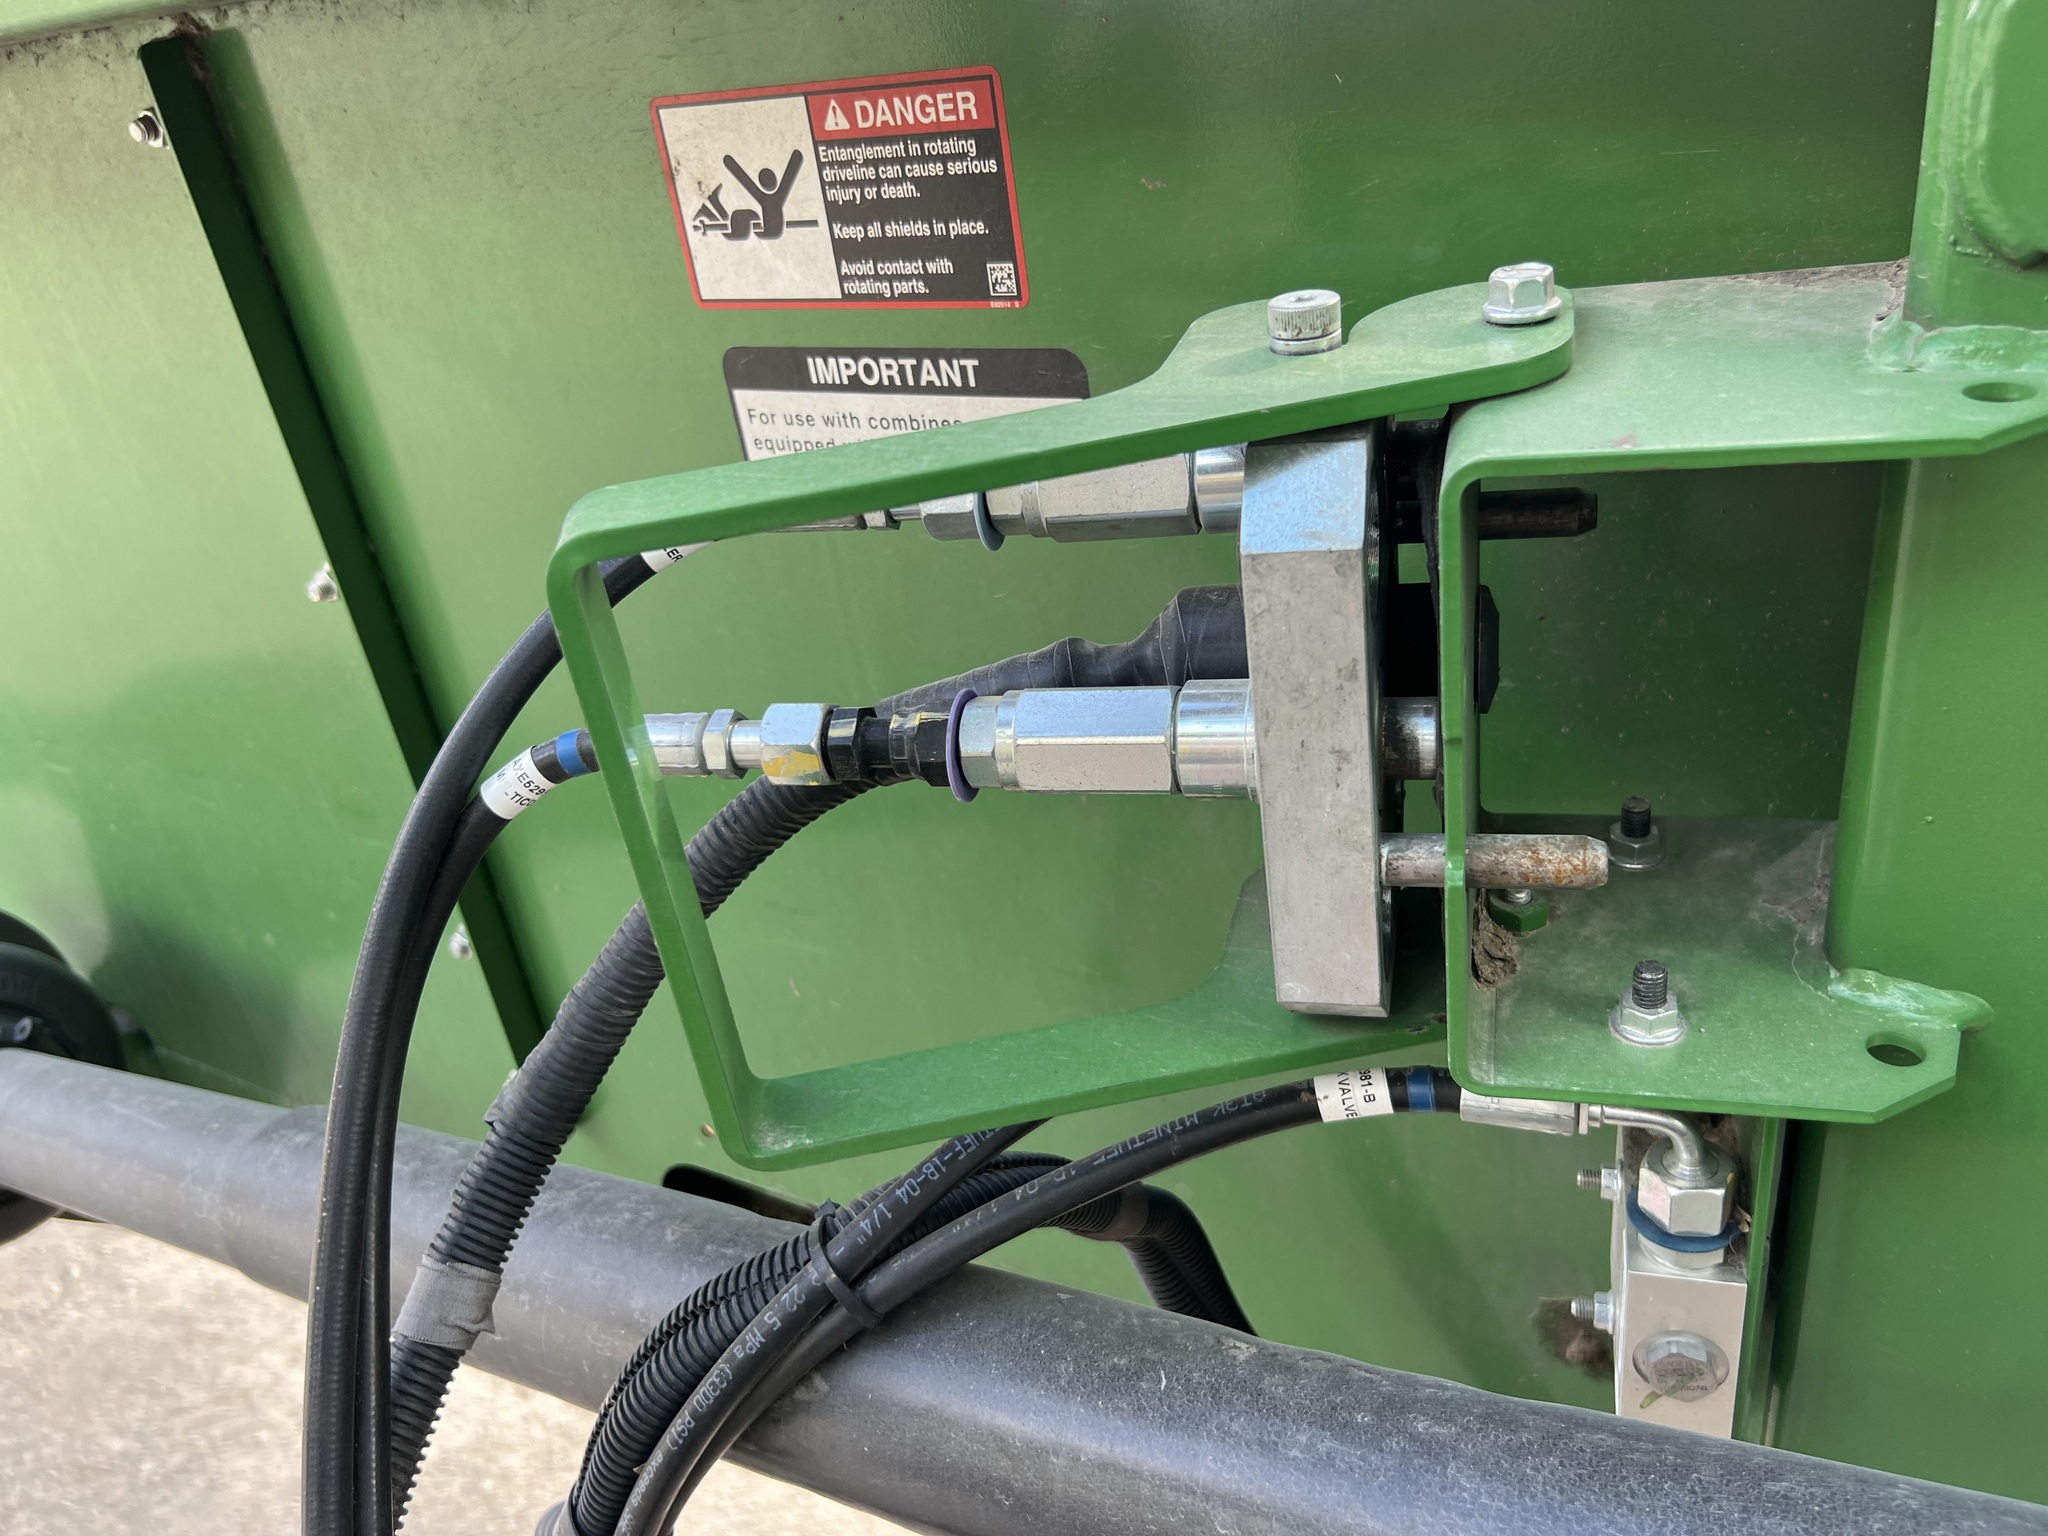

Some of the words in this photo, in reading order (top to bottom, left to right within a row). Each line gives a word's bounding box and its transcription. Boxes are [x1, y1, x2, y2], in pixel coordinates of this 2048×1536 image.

[854, 91, 978, 128] DANGER
[818, 141, 906, 164] Entanglement
[908, 140, 921, 157] in
[923, 137, 976, 158] rotating
[822, 164, 876, 183] driveline
[878, 166, 901, 180] can
[905, 163, 944, 178] cause
[946, 157, 998, 175] serious
[825, 183, 861, 205] injury
[864, 187, 878, 199] or
[881, 181, 921, 199] death.
[832, 223, 864, 242] Keep
[867, 221, 882, 238] all
[885, 219, 931, 237] shields
[933, 219, 946, 236] in
[949, 218, 989, 239] place.
[841, 259, 875, 276] Avoid
[877, 259, 924, 276] contact
[926, 257, 954, 274] with
[843, 278, 891, 297] rotating
[893, 278, 930, 297] parts.
[807, 356, 979, 388] IMPORTANT
[747, 408, 776, 425] For
[784, 412, 815, 427] use
[821, 411, 861, 429] with
[512, 758, 551, 797] AXE529
[1358, 1068, 1376, 1103] 981-B
[733, 1327, 767, 1359] MPa
[630, 1449, 664, 1507] exceeds
